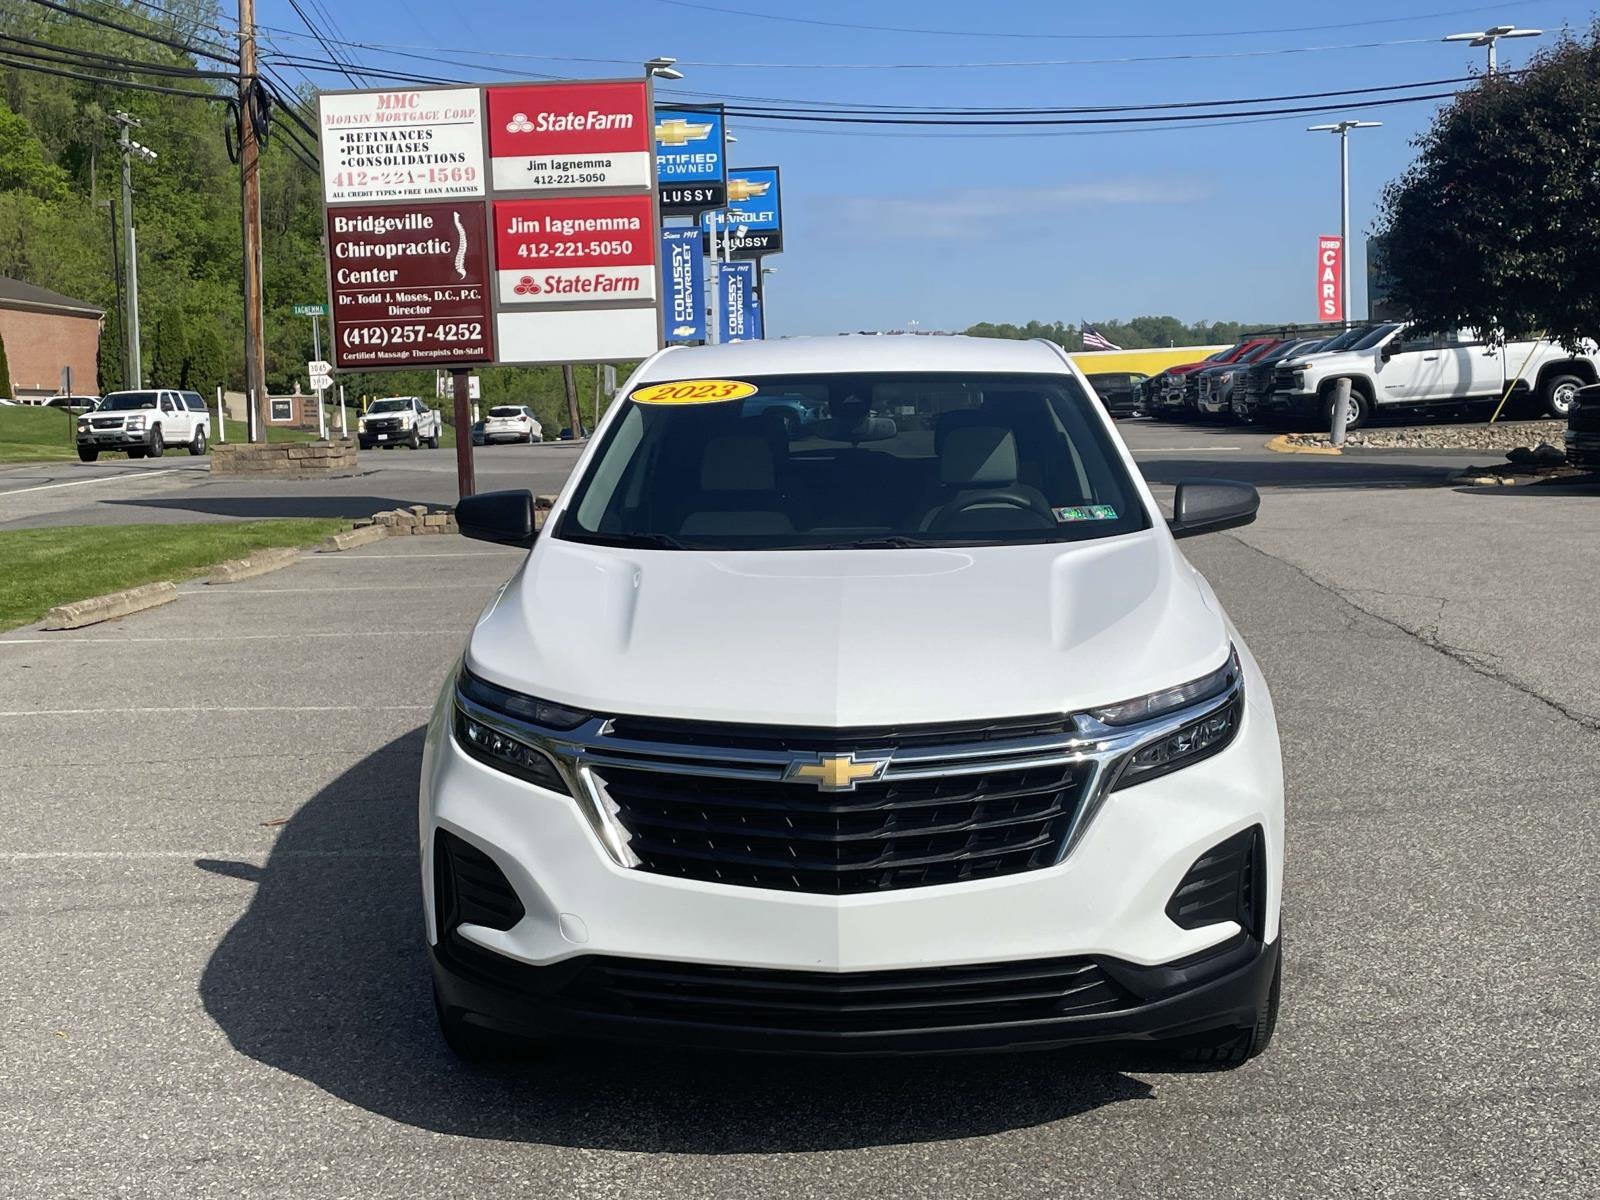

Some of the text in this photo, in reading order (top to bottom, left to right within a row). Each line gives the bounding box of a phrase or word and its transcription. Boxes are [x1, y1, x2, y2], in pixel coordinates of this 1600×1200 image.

[377, 93, 420, 109] MMC
[375, 110, 439, 122] MORTGAGE
[444, 108, 477, 119] CORP.
[346, 129, 433, 143] REFINANCES
[346, 142, 430, 155] PURCHASES
[348, 153, 466, 167] CONSOLIDATIONS
[527, 159, 612, 172] Jim Iagnemma
[656, 153, 717, 165] RTIFIED
[656, 163, 714, 174] E-OWNED
[332, 167, 476, 187] 412-221-1569
[533, 173, 606, 185] 412-221-5050
[347, 190, 373, 198] CREDIT
[375, 189, 397, 197] TYPES
[445, 185, 478, 194] ANALYSIS
[663, 190, 713, 203] LUSSY
[334, 213, 434, 234] Bridgeville
[507, 216, 640, 236] Jim Iagnemma
[335, 238, 451, 259] Chiropractic
[517, 240, 633, 258] 412-221-5050
[1321, 240, 1341, 249] USED
[337, 268, 398, 284] Center
[672, 243, 685, 321] COLUSSY
[683, 242, 694, 321] CHEVROLET
[1322, 250, 1336, 315] CARS
[339, 289, 481, 305] Dr. Todd J. Moses, D.C., P.C.
[388, 305, 432, 316] Director
[728, 275, 737, 335] COLUSSY
[343, 347, 484, 360] Certified Massage Therapists On-Staff
[648, 384, 738, 401] 2023
